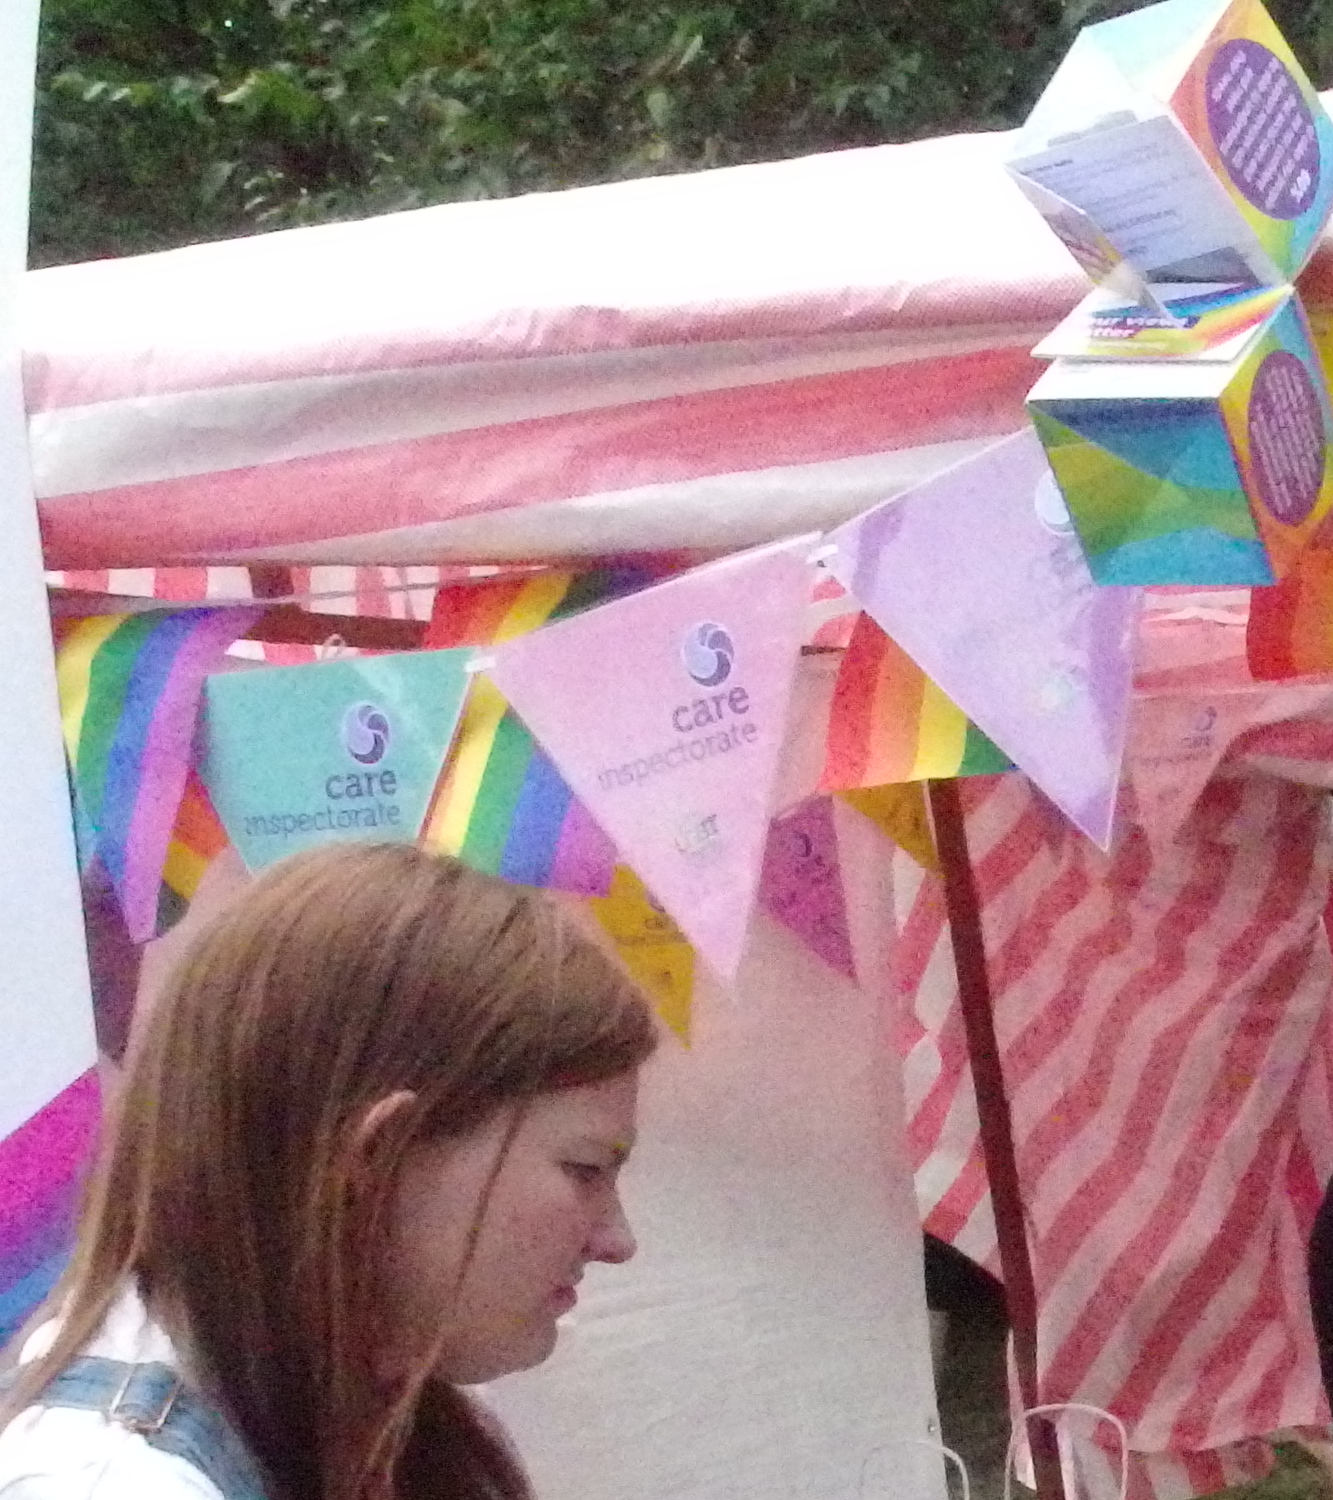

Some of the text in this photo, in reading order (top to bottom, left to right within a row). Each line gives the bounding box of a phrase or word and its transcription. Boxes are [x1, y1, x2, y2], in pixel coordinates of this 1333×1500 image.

[672, 684, 750, 735] care
[597, 719, 759, 794] inspectorate
[325, 768, 399, 799] care
[243, 800, 401, 837] inspectorate
